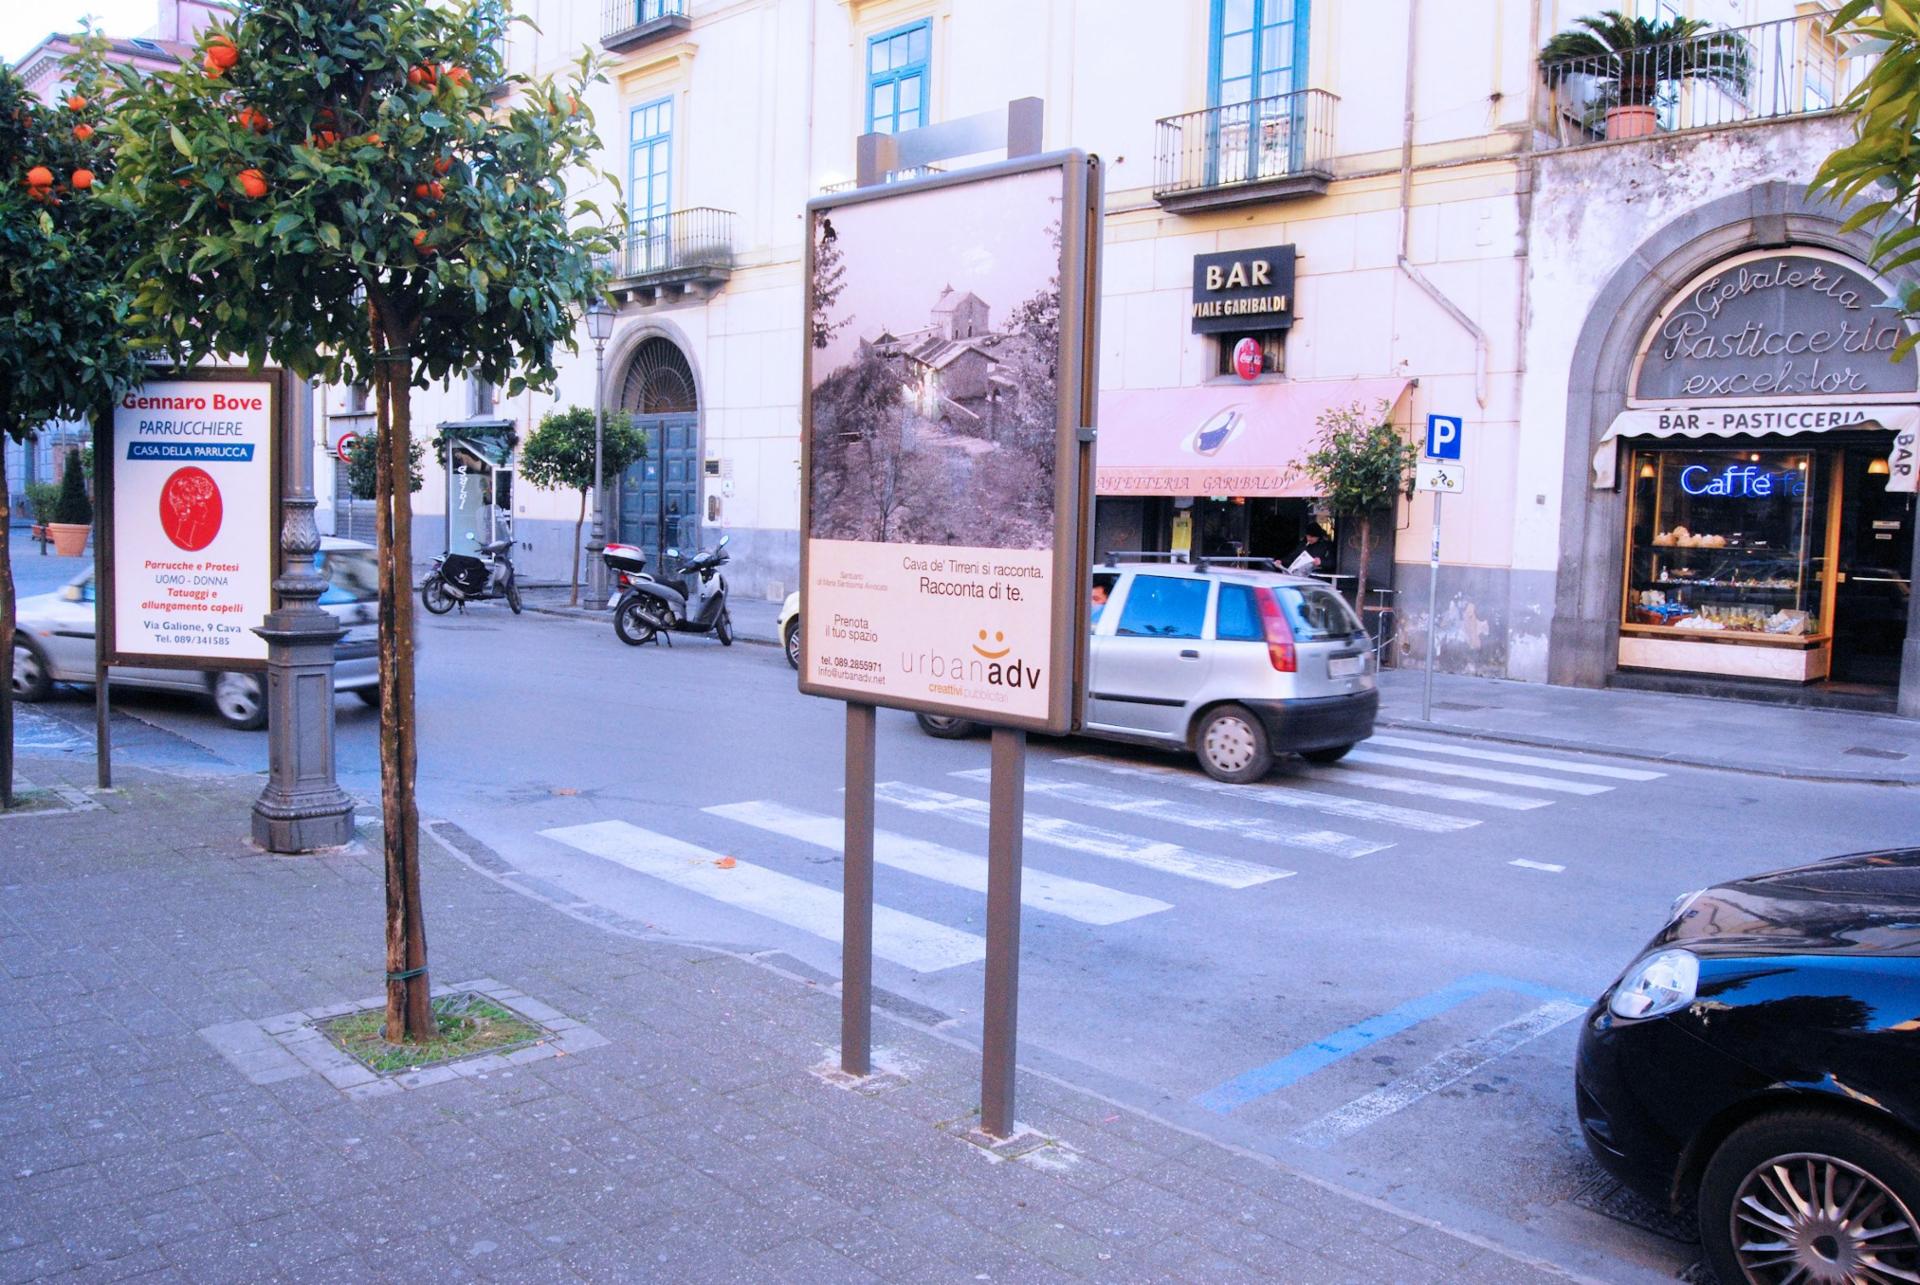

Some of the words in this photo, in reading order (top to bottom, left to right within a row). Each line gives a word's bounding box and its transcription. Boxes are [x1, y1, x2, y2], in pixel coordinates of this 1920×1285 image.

[1206, 261, 1272, 290] BAR
[1696, 261, 1859, 319] Gelateria
[1192, 301, 1222, 318] VIALE
[1224, 295, 1287, 315] GARIBALDI
[1663, 311, 1901, 360] Pasticceria
[122, 393, 206, 410] Gennaro
[213, 394, 262, 410] Bove
[139, 420, 243, 435] PARRUCCHIERE
[1659, 414, 1700, 430] BAR
[1723, 411, 1865, 429] PASTICCERIA
[1433, 418, 1456, 454] P
[133, 446, 160, 456] CASA
[162, 446, 192, 457] DELLA
[194, 446, 248, 458] PARRUCCA
[1894, 434, 1915, 476] BAR
[1097, 477, 1189, 491] AFFETTERIA
[1203, 476, 1292, 492] GARIBALDI
[145, 561, 193, 571] Parrucche
[196, 563, 202, 571] e
[205, 562, 239, 572] Protesi
[903, 556, 927, 572] Cava
[949, 560, 979, 574] Tirreni
[982, 563, 990, 575] si
[994, 565, 1044, 579] racconta.
[155, 574, 185, 584] UOMO
[193, 576, 228, 586] DONNA
[168, 588, 209, 600] Tatuaggi
[920, 577, 984, 598] Racconta
[989, 582, 1001, 600] di
[1006, 584, 1024, 602] te.
[141, 601, 208, 613] allungamento
[211, 603, 243, 614] capelli
[144, 621, 160, 630] Via
[163, 621, 205, 633] Galione,
[207, 623, 213, 631] 9
[217, 624, 242, 633] Cava
[834, 614, 869, 630] Prenota
[155, 634, 172, 644] Tel.
[174, 635, 230, 646] 089/341585
[825, 625, 830, 637] il
[832, 627, 846, 639] tuo
[848, 630, 878, 644] spazio
[821, 655, 832, 666] tel.
[834, 657, 882, 672] 089.2855971
[901, 648, 1041, 690] urbanadv
